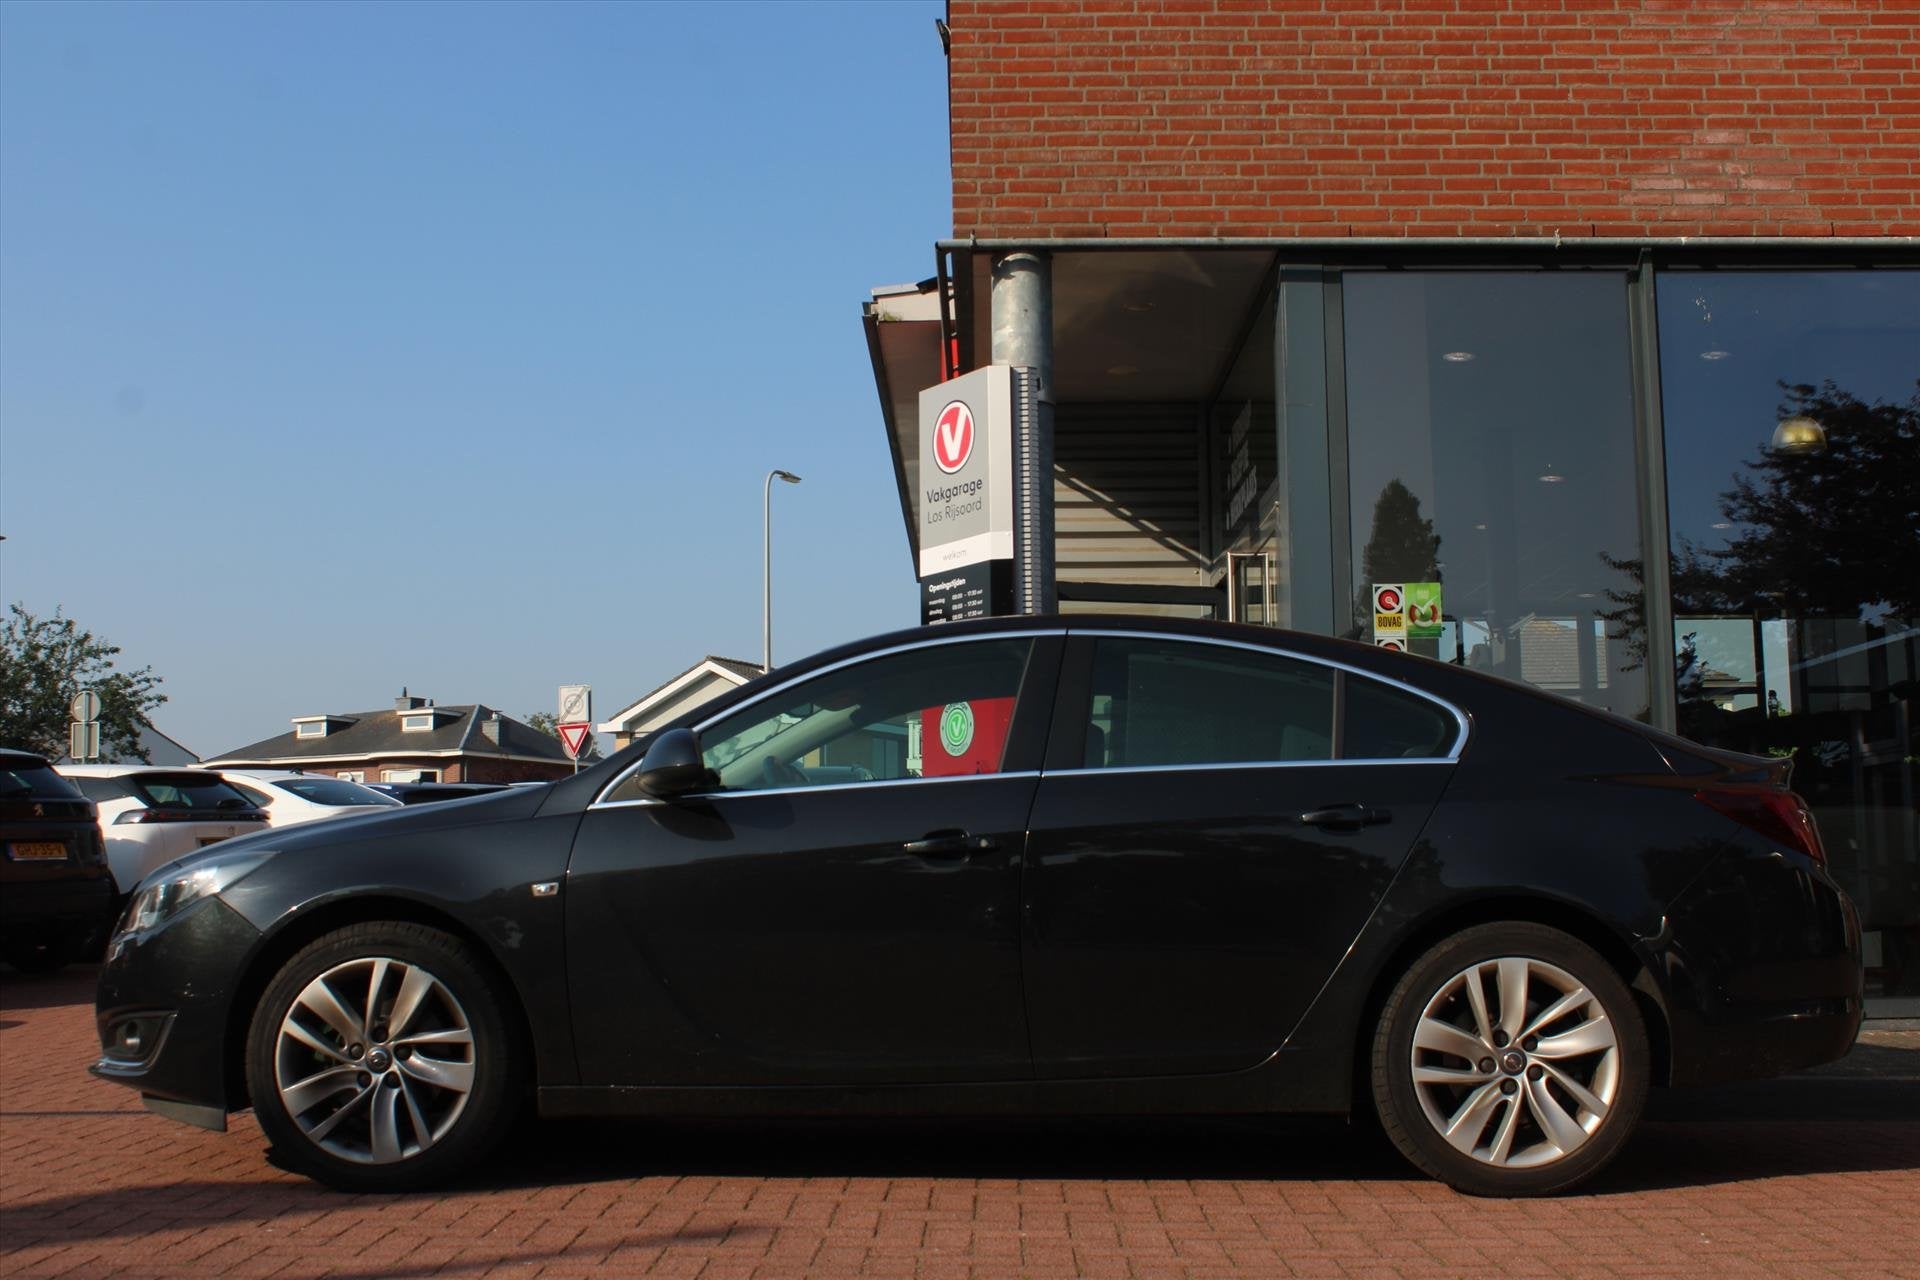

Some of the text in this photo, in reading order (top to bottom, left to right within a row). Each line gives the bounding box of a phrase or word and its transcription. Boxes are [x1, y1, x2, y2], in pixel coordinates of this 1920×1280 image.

[926, 479, 983, 504] Vakgarage
[927, 496, 982, 524] Los Rijsoord
[1377, 615, 1402, 628] BOVAG
